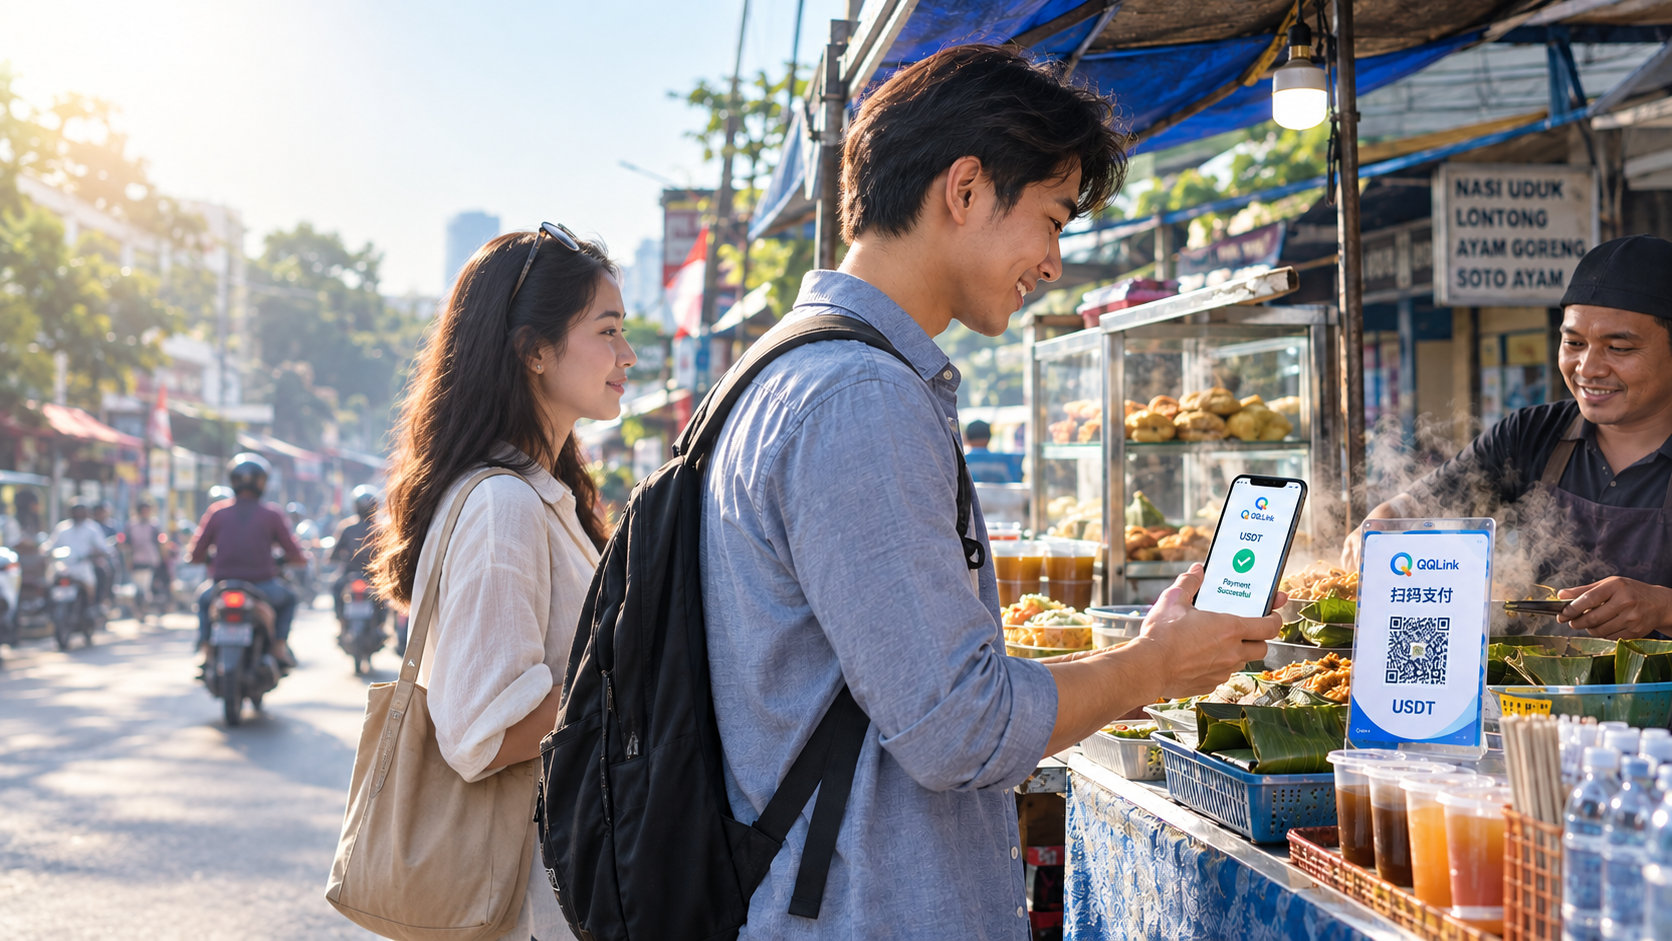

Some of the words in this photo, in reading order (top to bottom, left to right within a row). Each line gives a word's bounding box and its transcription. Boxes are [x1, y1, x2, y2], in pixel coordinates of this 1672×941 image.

[1456, 178, 1502, 198] NASI
[1508, 179, 1563, 199] UDUK
[1457, 208, 1547, 228] LONTONG
[1457, 239, 1506, 257] AYAM
[1511, 239, 1586, 258] GORENG
[1457, 268, 1506, 288] SOTO
[1512, 269, 1563, 288] AYAM
[1240, 532, 1263, 542] USDT
[1417, 559, 1459, 570] QQLink
[1223, 578, 1250, 589] Payment
[1217, 587, 1251, 598] Successful
[1391, 587, 1453, 603] 扫码支付
[1392, 699, 1435, 715] USDT
